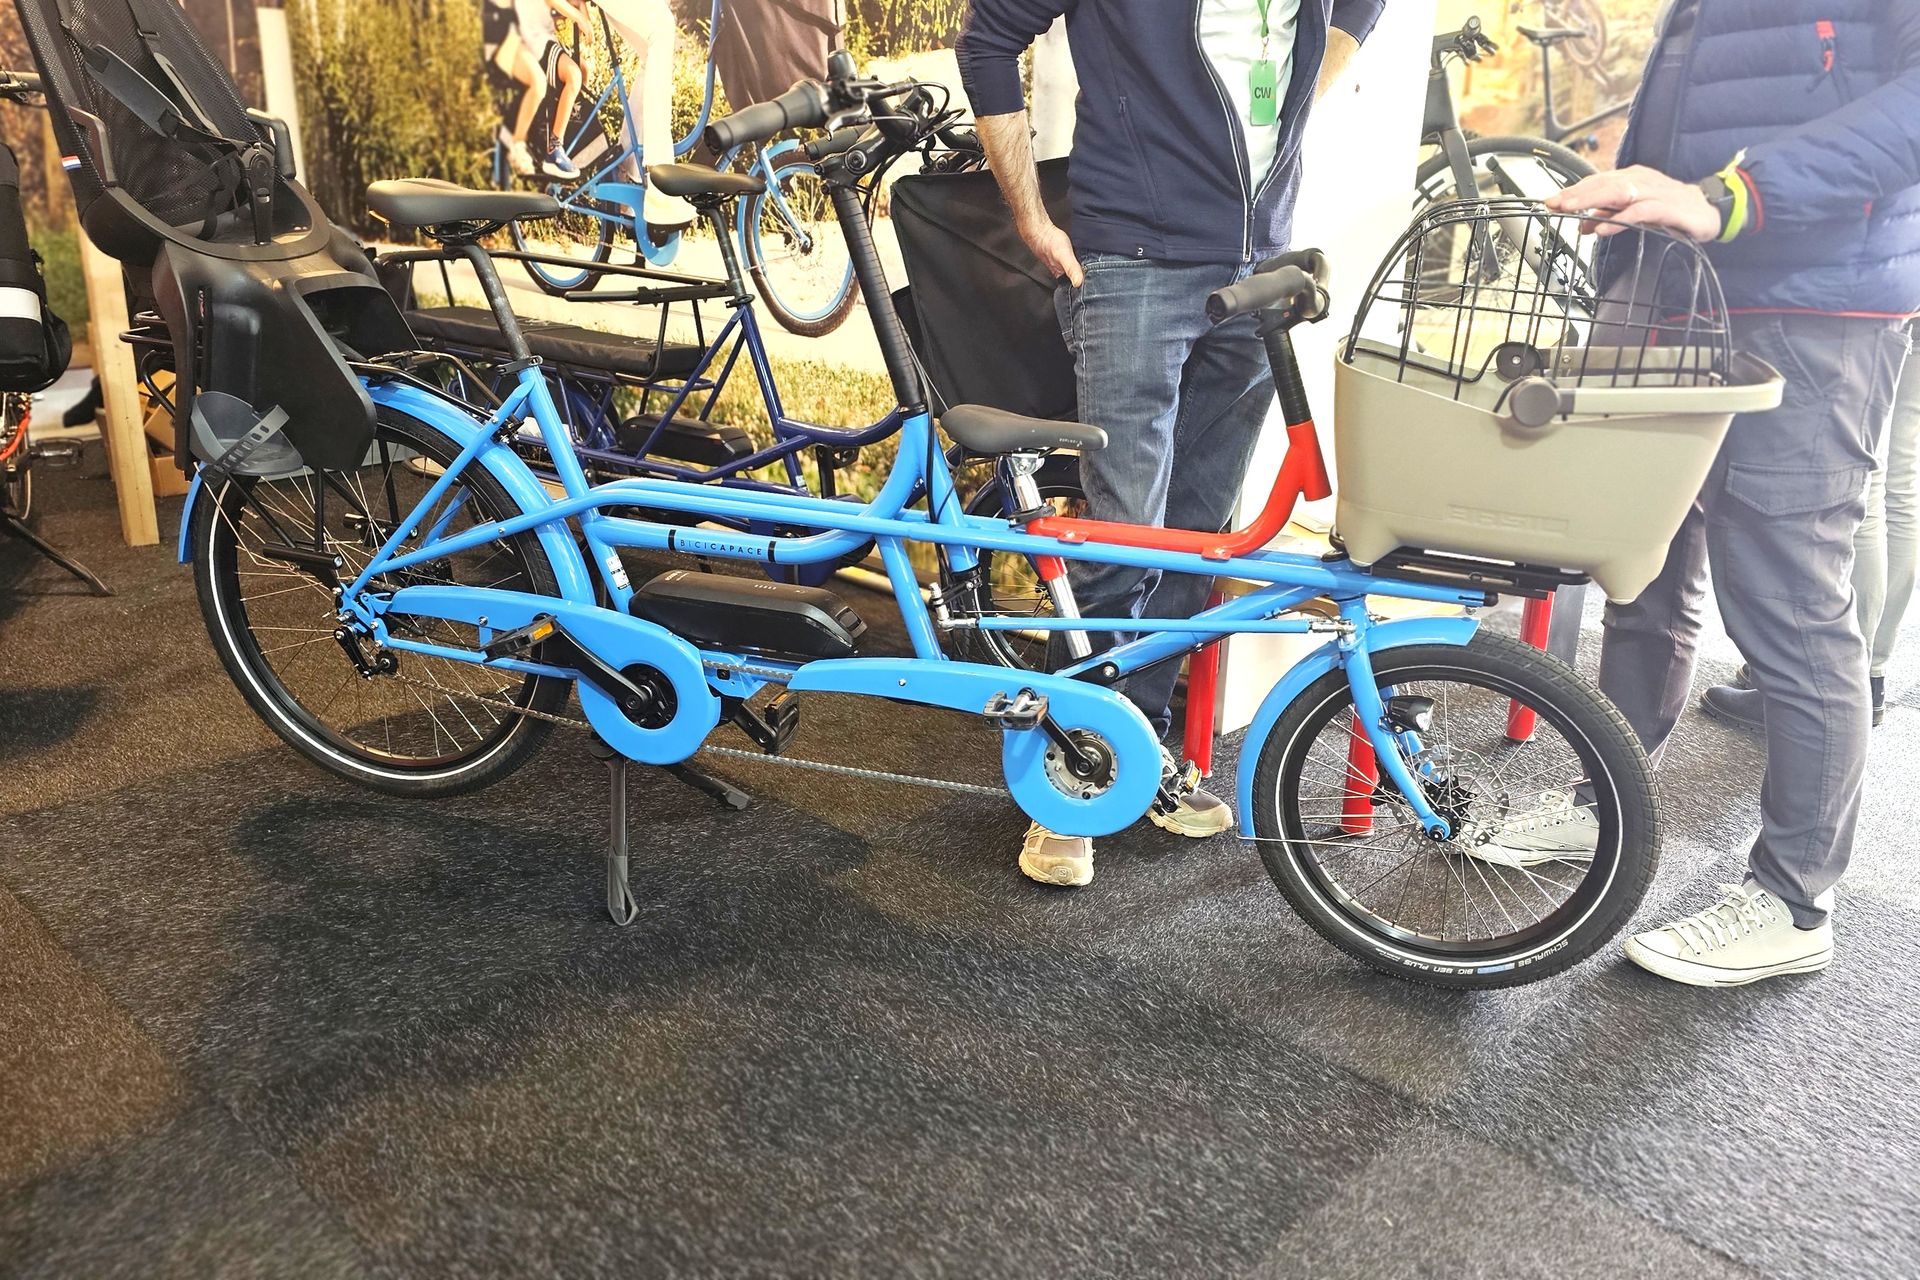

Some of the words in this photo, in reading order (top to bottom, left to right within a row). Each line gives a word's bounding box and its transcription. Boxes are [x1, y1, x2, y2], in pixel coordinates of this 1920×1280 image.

[1254, 86, 1271, 99] CW
[680, 539, 762, 556] BICICAPACE
[1518, 938, 1569, 968] SCHWALBE
[1402, 959, 1430, 971] PLUS
